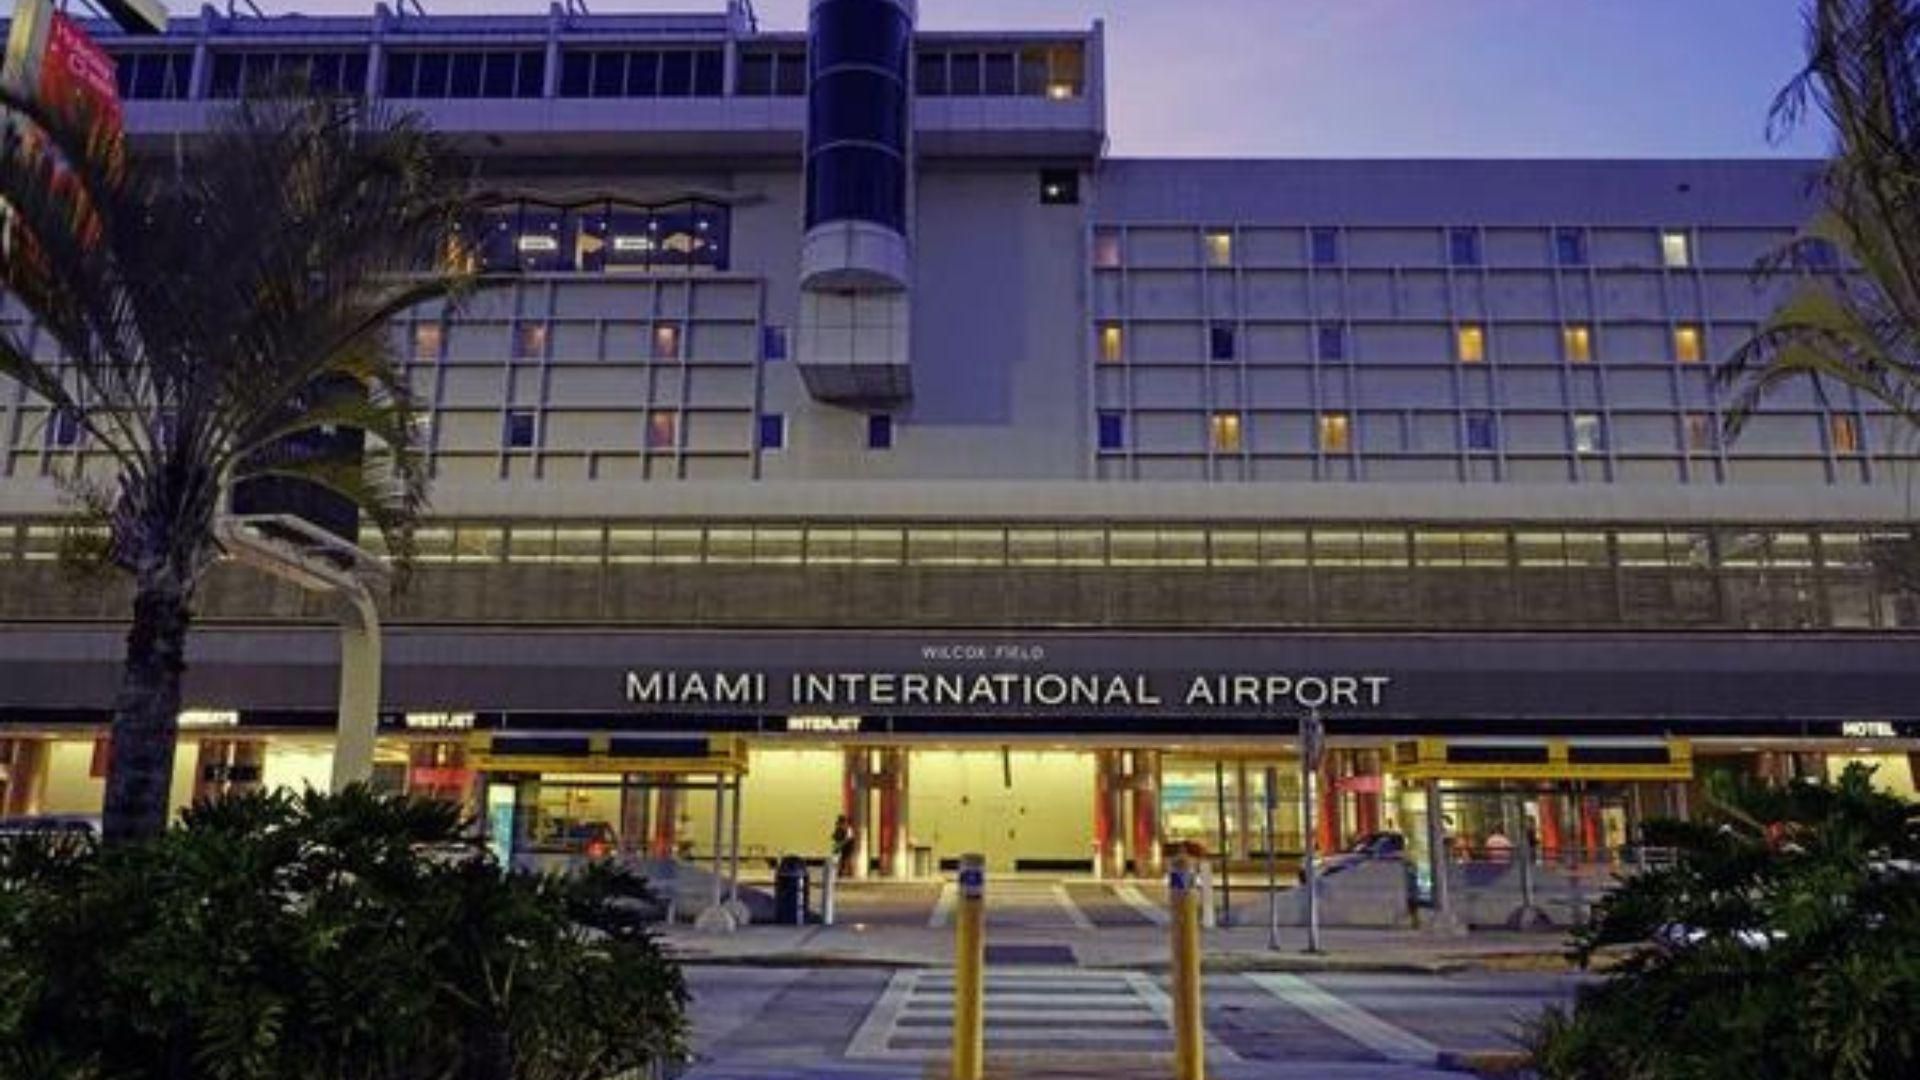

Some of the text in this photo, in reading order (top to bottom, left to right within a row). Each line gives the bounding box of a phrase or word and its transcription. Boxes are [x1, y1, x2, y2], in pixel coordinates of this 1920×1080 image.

[921, 645, 986, 660] WILCOX
[625, 671, 1390, 708] MIAMI INTERNATIONAL AIRPORT
[787, 715, 861, 731] INTERJET
[1842, 721, 1897, 737] HOTEL
